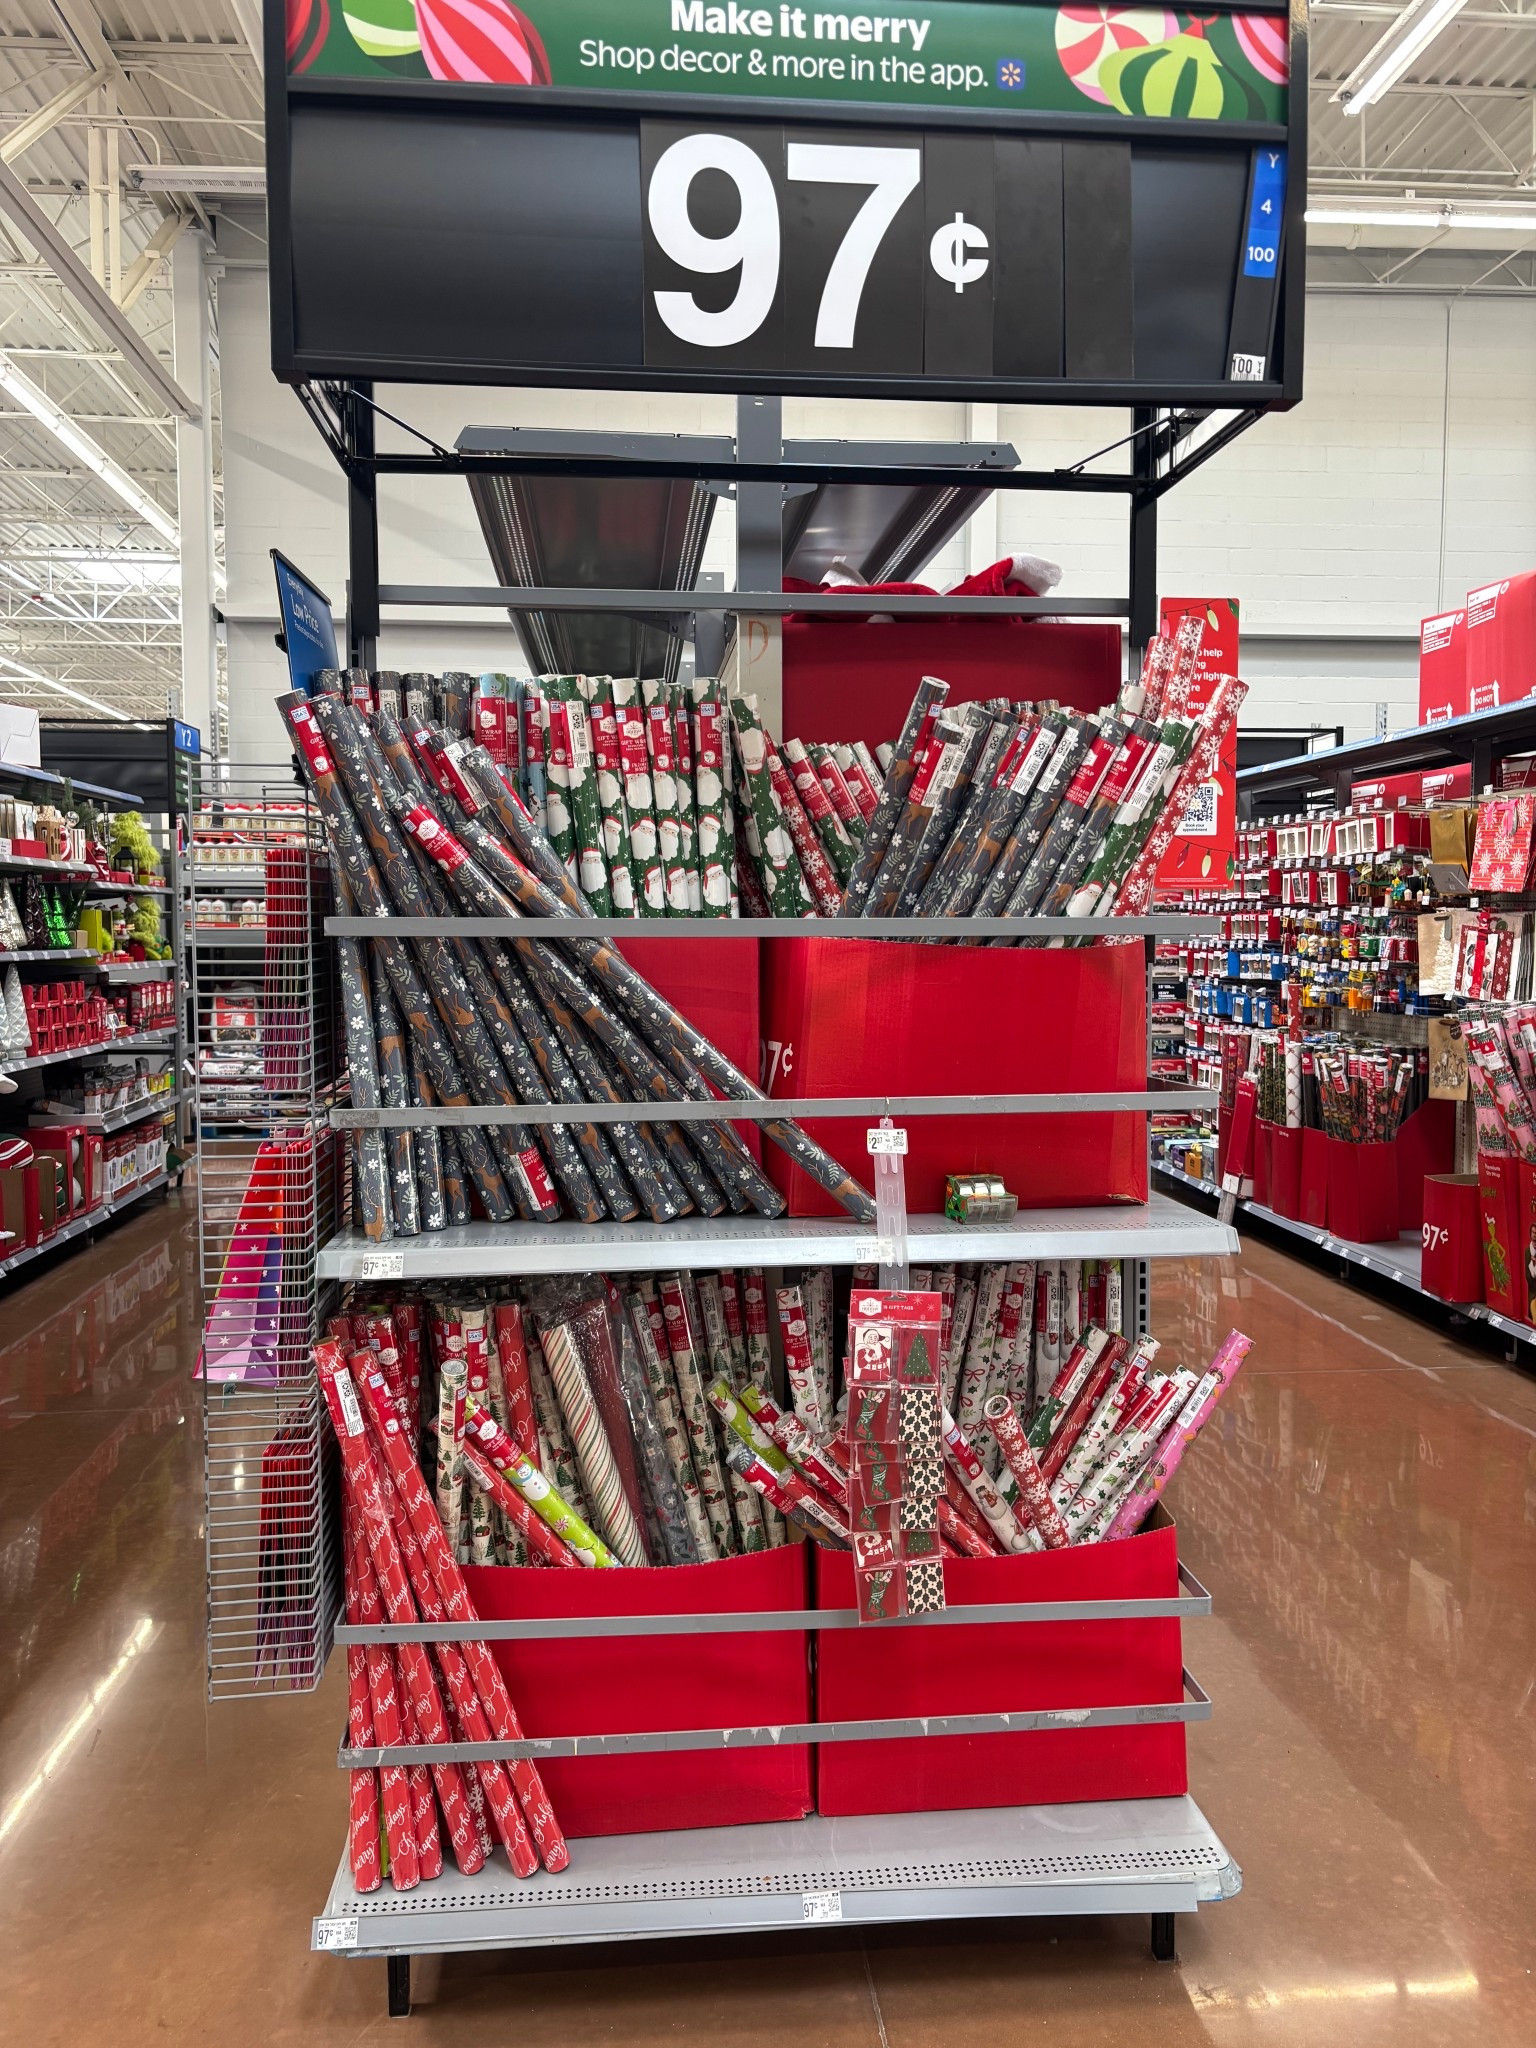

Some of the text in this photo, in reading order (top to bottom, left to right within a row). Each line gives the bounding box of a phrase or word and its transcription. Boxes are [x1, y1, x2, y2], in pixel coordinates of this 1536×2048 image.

[671, 0, 931, 51] Make it merry
[579, 39, 989, 91] Shop decor & more in the app.
[1268, 152, 1280, 169] Y
[1260, 198, 1272, 215] 4
[1248, 245, 1275, 263] 100
[1203, 647, 1223, 659] help
[1103, 743, 1114, 752] 97¢
[1136, 738, 1147, 748] 97¢
[1422, 1222, 1449, 1251] 97¢
[803, 1902, 818, 1918] 97¢
[318, 1929, 334, 1945] 97¢
